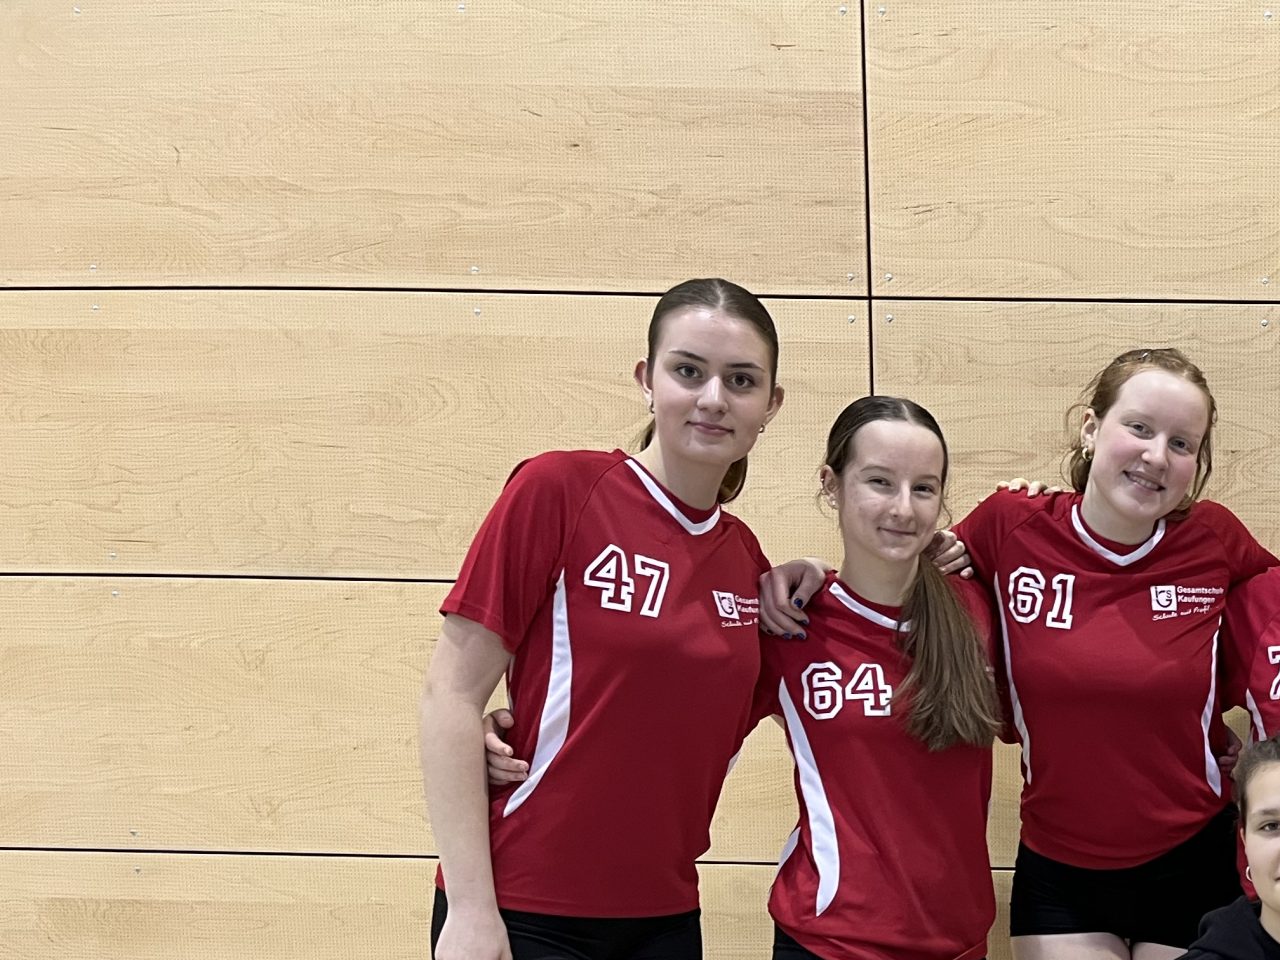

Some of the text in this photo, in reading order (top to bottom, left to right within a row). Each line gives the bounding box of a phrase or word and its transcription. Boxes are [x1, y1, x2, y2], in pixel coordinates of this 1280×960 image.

[583, 543, 670, 618] 47
[1008, 566, 1075, 630] 61
[801, 662, 893, 720] 64
